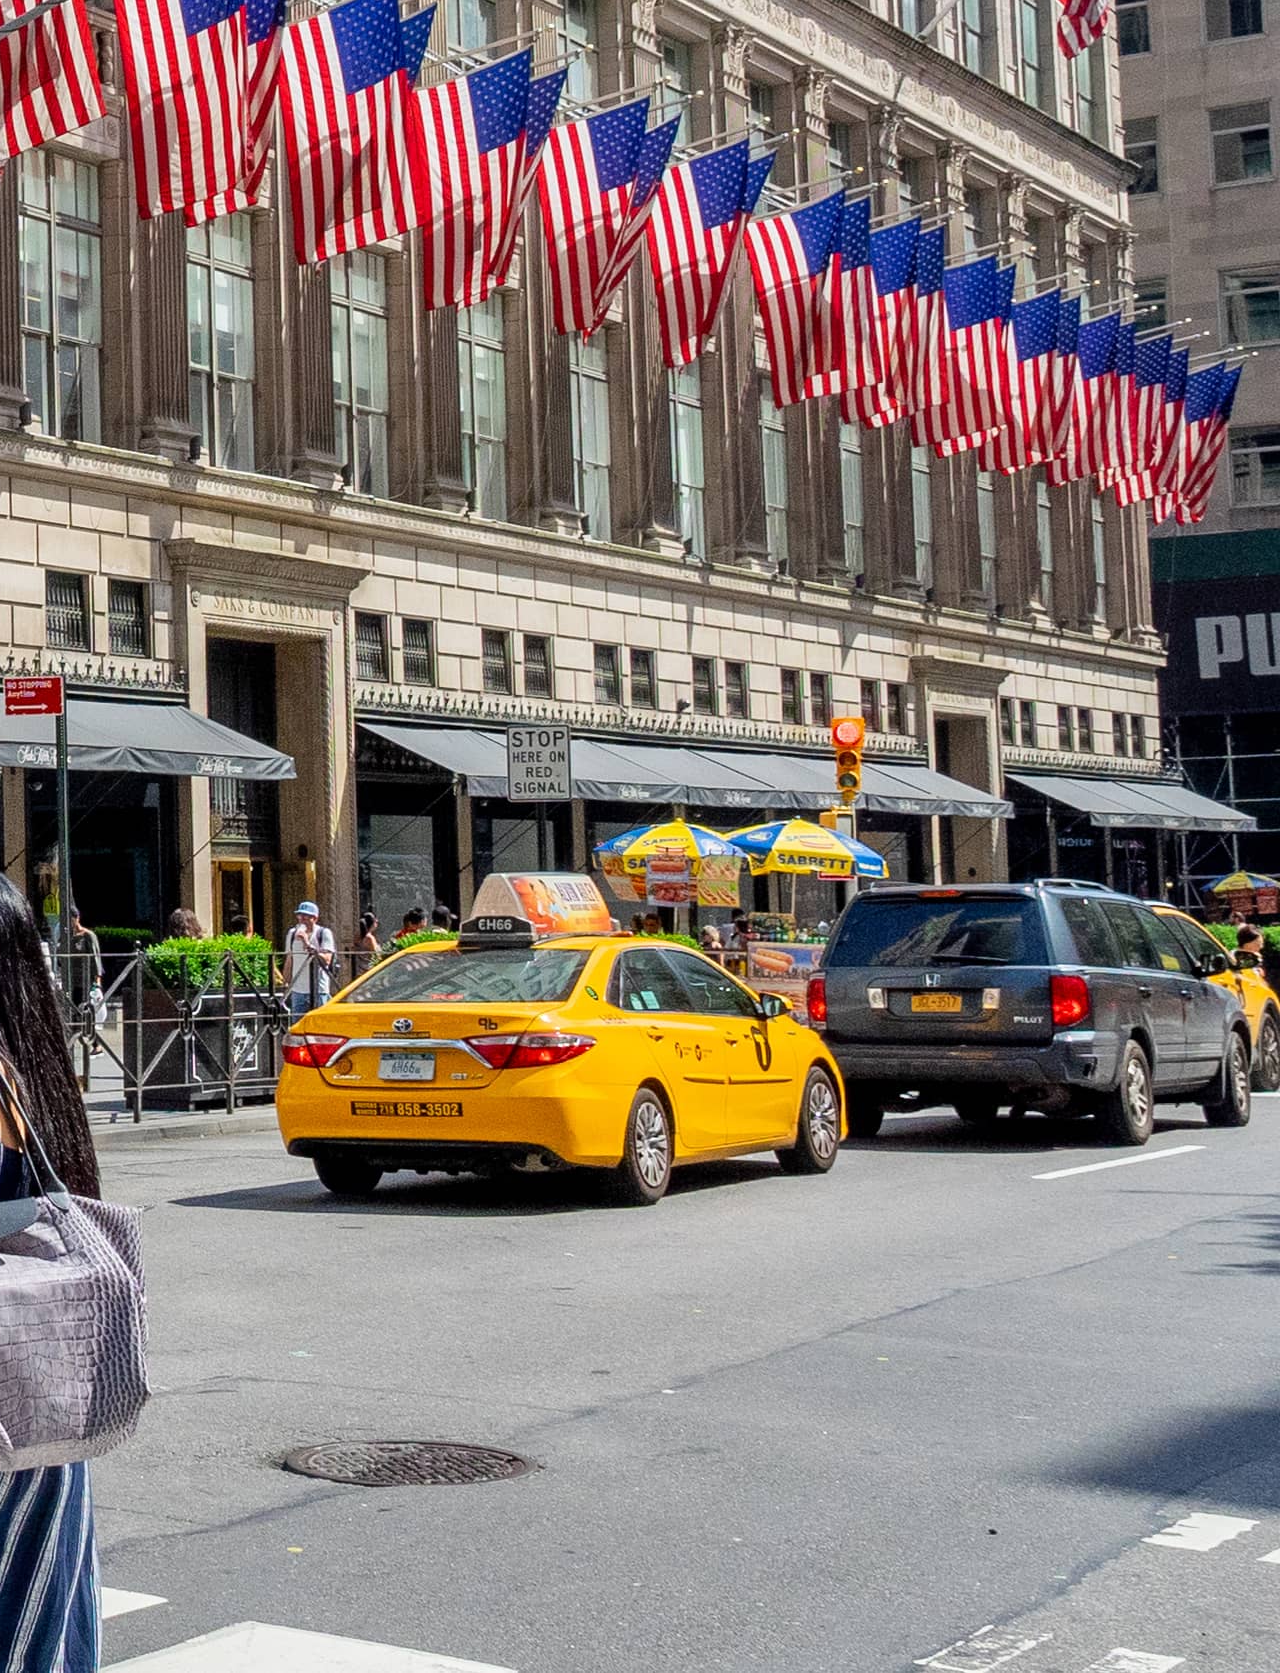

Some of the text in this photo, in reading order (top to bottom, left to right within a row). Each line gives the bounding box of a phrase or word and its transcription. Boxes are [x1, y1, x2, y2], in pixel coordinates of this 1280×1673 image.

[213, 590, 244, 613] SAKS
[511, 730, 565, 747] STOP
[512, 751, 565, 763] HERE ON
[525, 766, 553, 778] RED
[514, 781, 566, 794] SIGNAL
[777, 853, 849, 870] SABRETT
